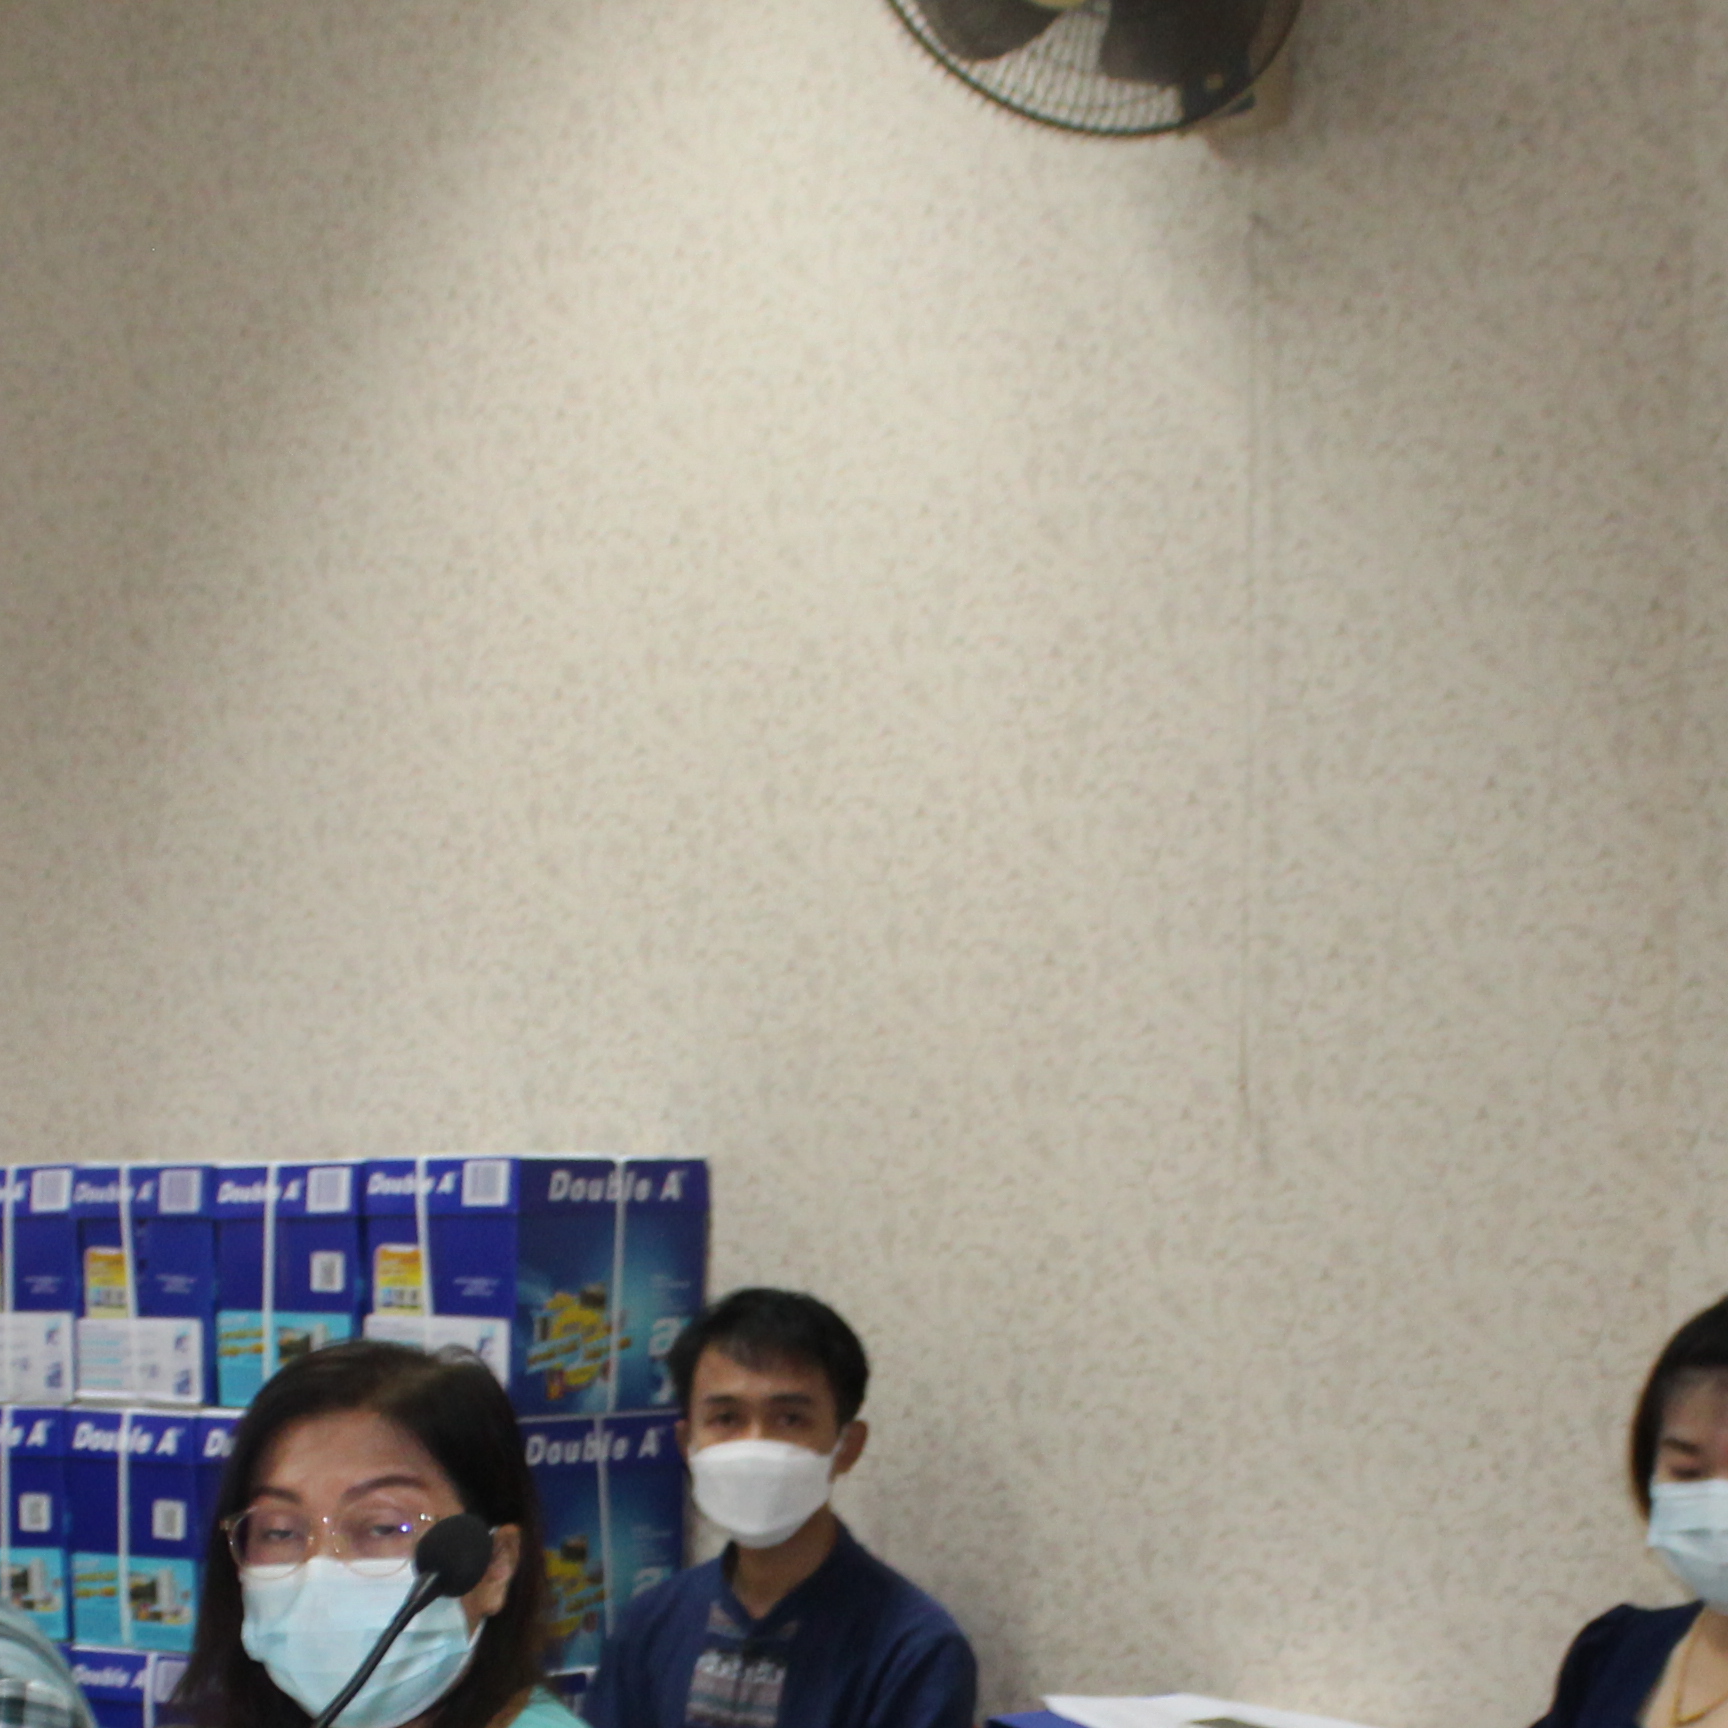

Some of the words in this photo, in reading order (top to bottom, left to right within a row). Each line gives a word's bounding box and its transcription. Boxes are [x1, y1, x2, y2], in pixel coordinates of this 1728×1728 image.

[367, 1170, 435, 1195] Doube
[660, 1169, 684, 1202] A
[72, 1421, 154, 1454] Doule
[637, 1427, 661, 1459] A
